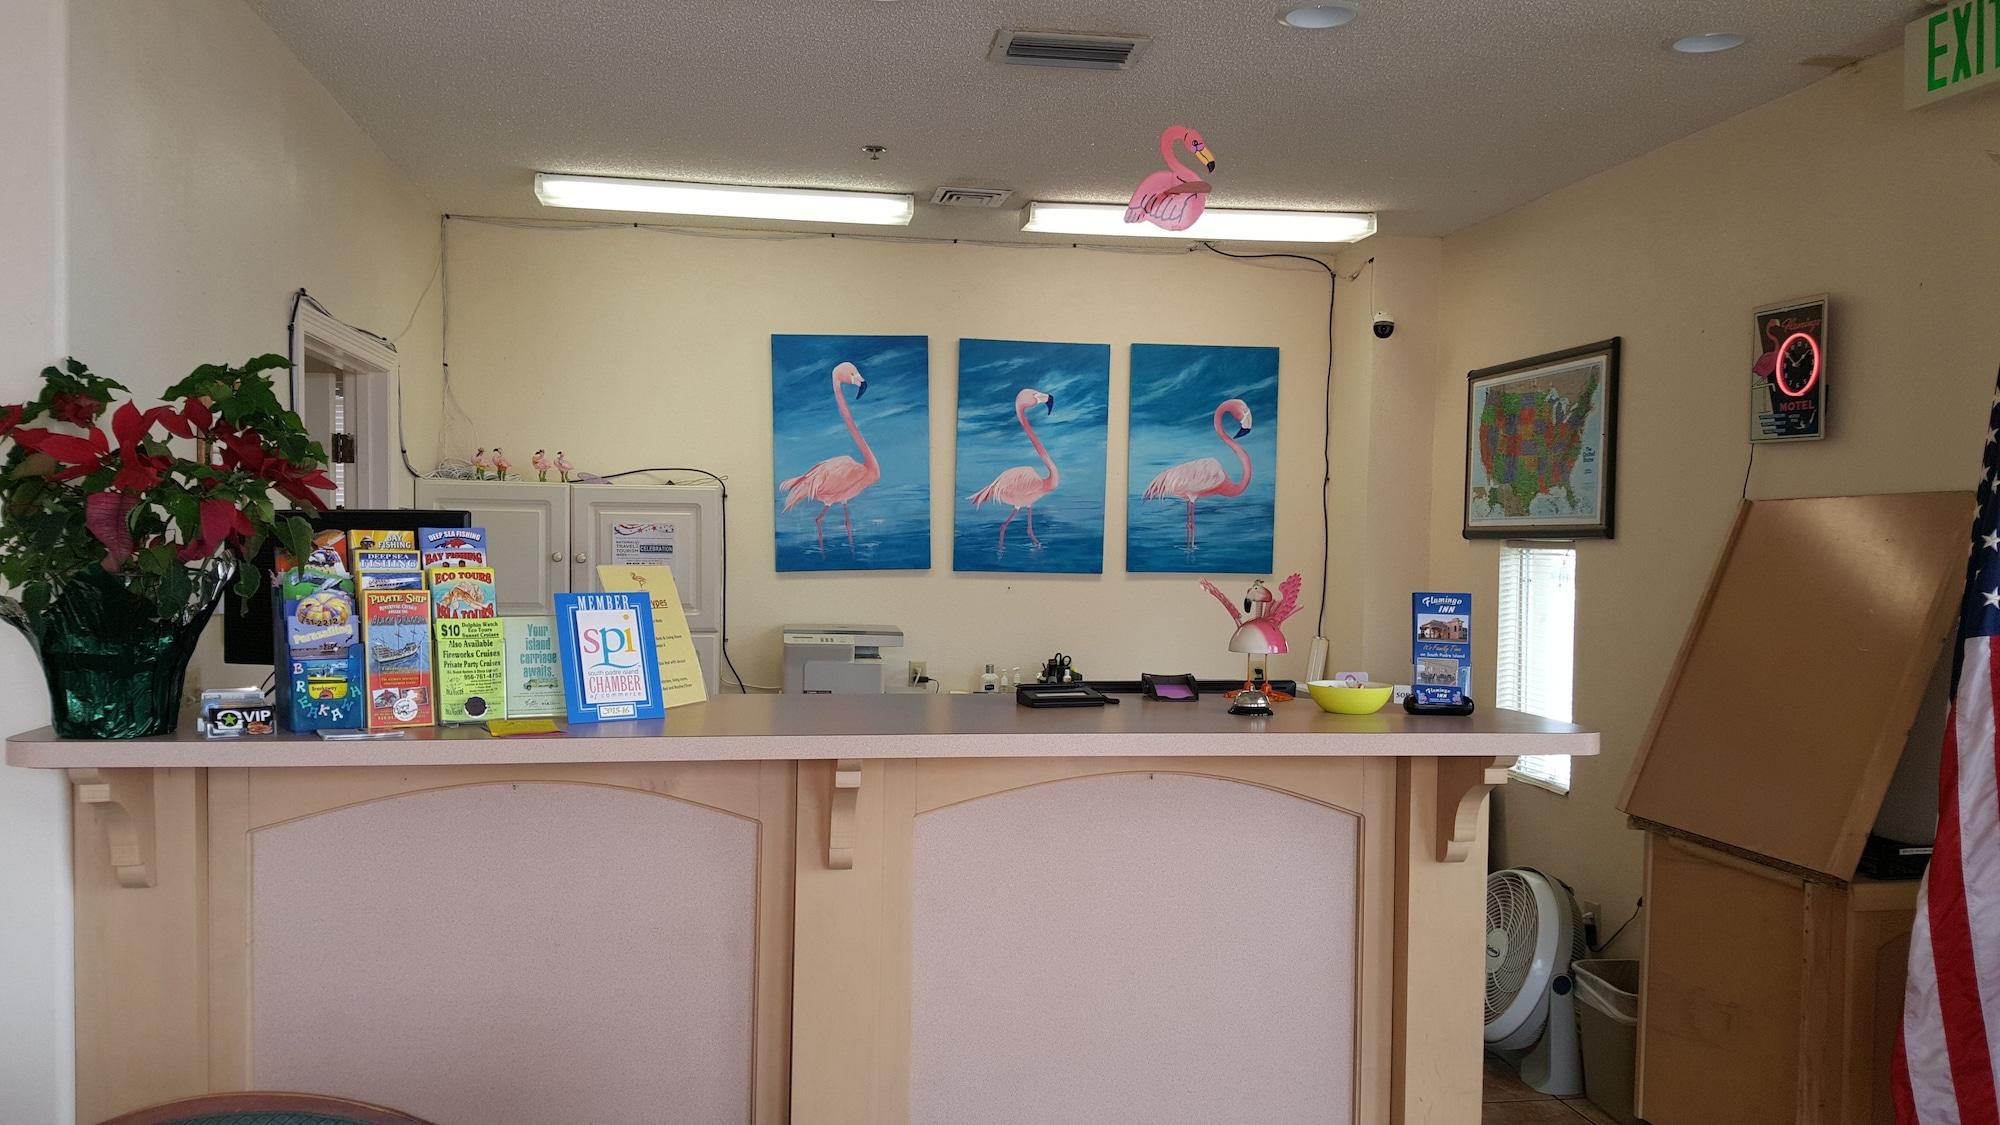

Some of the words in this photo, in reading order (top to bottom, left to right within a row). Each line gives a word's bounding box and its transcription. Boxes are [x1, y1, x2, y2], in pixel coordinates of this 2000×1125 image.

[1927, 0, 2000, 92] EXIT
[1780, 400, 1815, 412] MOTEL
[428, 532, 443, 541] DEEP
[456, 530, 481, 541] FISHING
[378, 541, 412, 549] FISHING
[425, 553, 444, 565] BAY
[445, 551, 483, 564] FISHING
[360, 560, 417, 569] FISHING
[434, 572, 456, 585] ECO
[457, 571, 492, 585] TOURS
[577, 594, 630, 610] MEMBER
[651, 599, 667, 609] ypes
[1422, 596, 1463, 607] Flamingo
[1438, 605, 1456, 613] INN
[441, 624, 460, 637] $10
[527, 623, 548, 637] Your
[448, 640, 462, 648] Also
[463, 639, 493, 648] Available
[525, 637, 551, 651] island
[583, 613, 637, 665] spi
[442, 650, 474, 659] Fireworks
[475, 649, 501, 658] Cruises
[519, 650, 557, 665] carriage
[443, 660, 463, 669] Private
[463, 660, 479, 669] Party
[523, 664, 555, 678] awaits.
[605, 669, 621, 677] padre
[622, 668, 639, 676] island
[588, 674, 642, 694] CHAMBER
[242, 710, 271, 722] VIP
